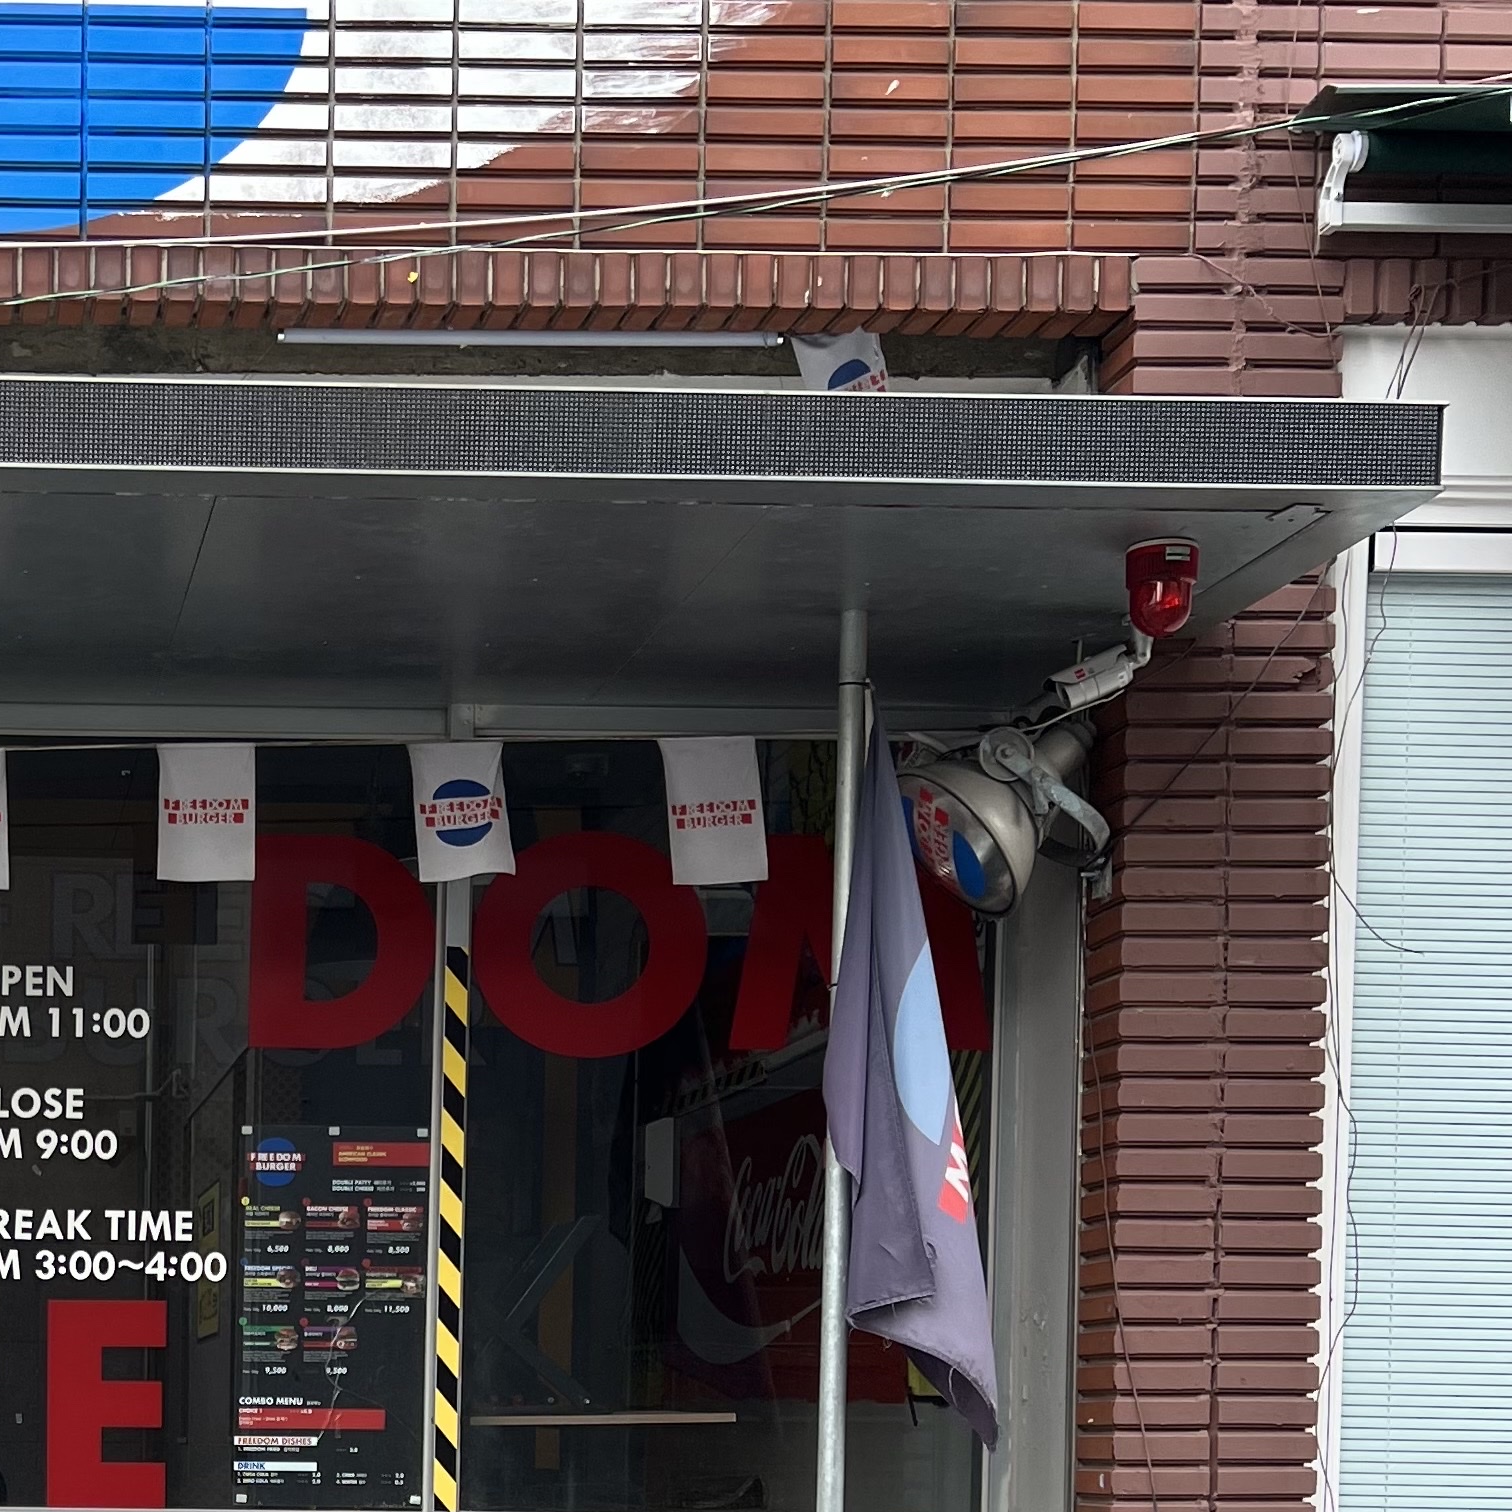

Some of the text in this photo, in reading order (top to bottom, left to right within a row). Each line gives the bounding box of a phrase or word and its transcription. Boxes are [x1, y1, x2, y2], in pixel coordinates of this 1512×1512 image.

[168, 798, 243, 811] FREEDOM
[425, 797, 497, 814] FREEDOM
[676, 799, 749, 816] FREEDOM
[177, 812, 235, 824] BURGER
[434, 810, 492, 827] BURGER
[684, 814, 743, 829] BURGER
[48, 1007, 150, 1038] 11:00
[36, 1128, 118, 1160] 9:00
[250, 1153, 302, 1162] FREEDOM
[255, 1162, 296, 1171] BURGER
[723, 1132, 828, 1284] Coca-Col
[104, 1210, 193, 1241] TIME
[35, 1250, 227, 1281] 3:00~4:00
[239, 1397, 274, 1405] COMBO
[276, 1397, 304, 1406] MENU
[238, 1437, 313, 1446] FREEDOM DISHES
[237, 1462, 266, 1470] DRINK
